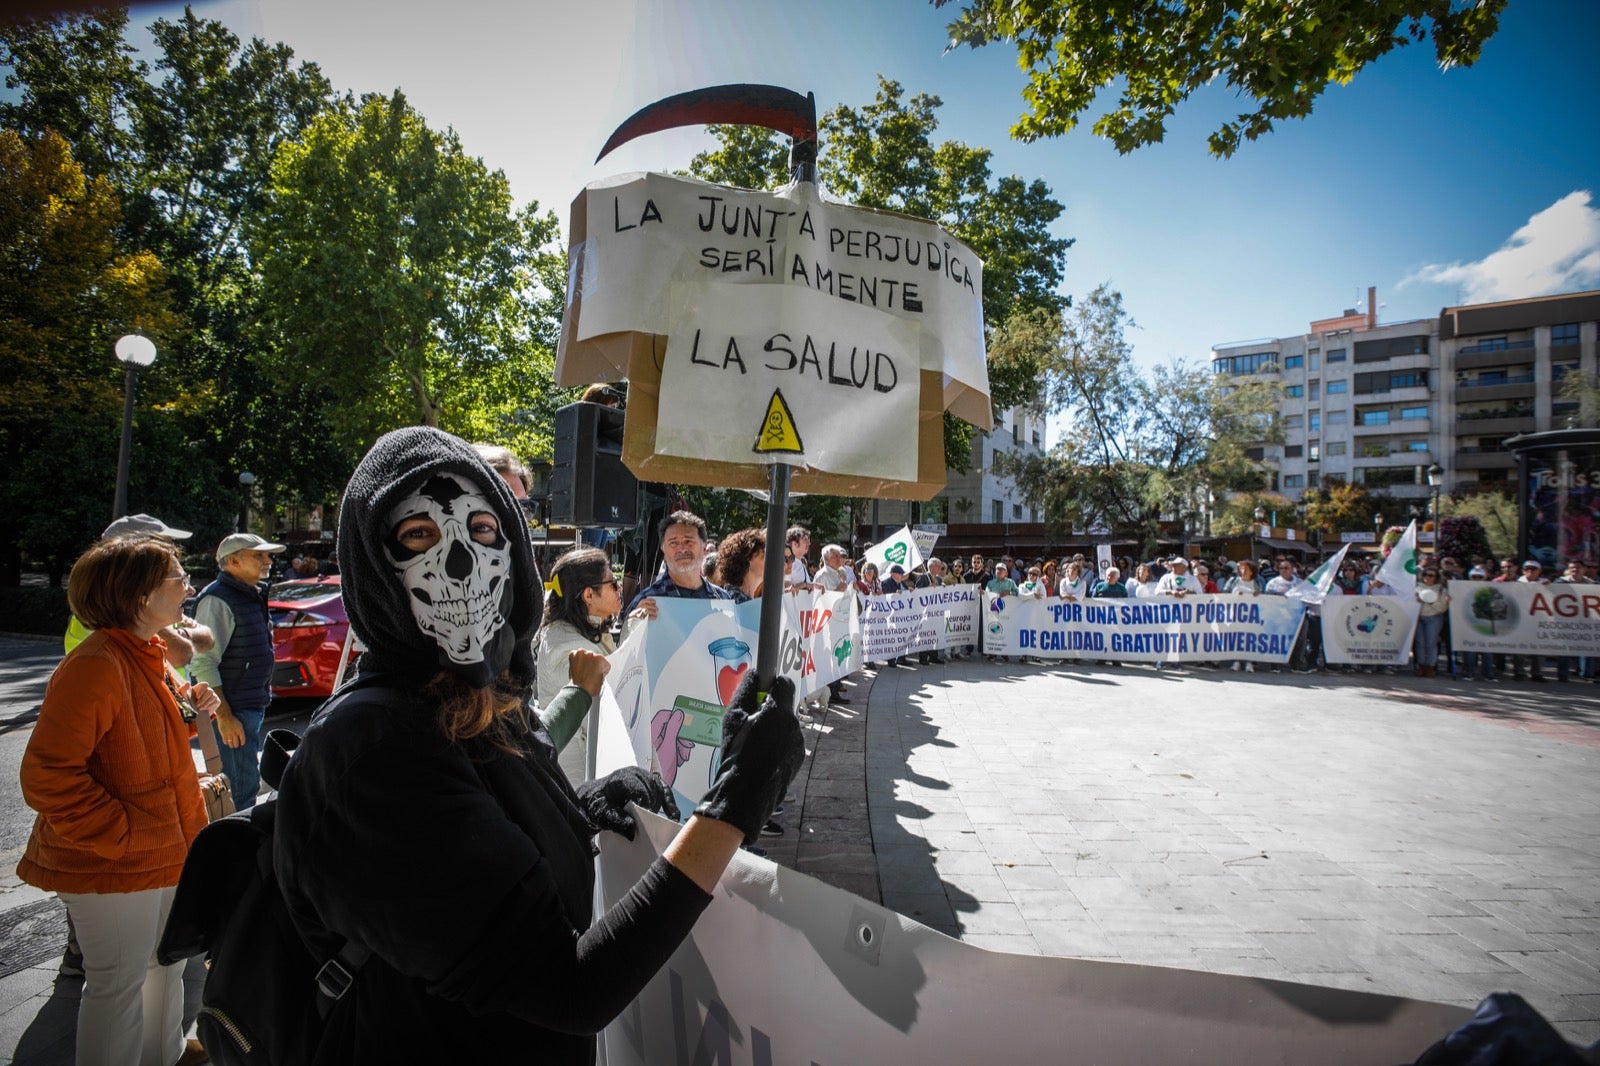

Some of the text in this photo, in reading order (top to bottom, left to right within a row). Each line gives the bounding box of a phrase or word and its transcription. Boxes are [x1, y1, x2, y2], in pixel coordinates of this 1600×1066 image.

[615, 196, 663, 233] LA
[691, 328, 898, 394] LA SALUD
[919, 589, 976, 607] UNIVERSAL
[1086, 605, 1118, 625] UNA
[1121, 604, 1192, 625] SANIDAD
[1196, 599, 1265, 626] PÚBLICA,
[1019, 629, 1037, 648] DE
[1040, 630, 1108, 653] CALIDAD,
[1111, 632, 1188, 653] GRATUITA
[1190, 632, 1200, 653] Y
